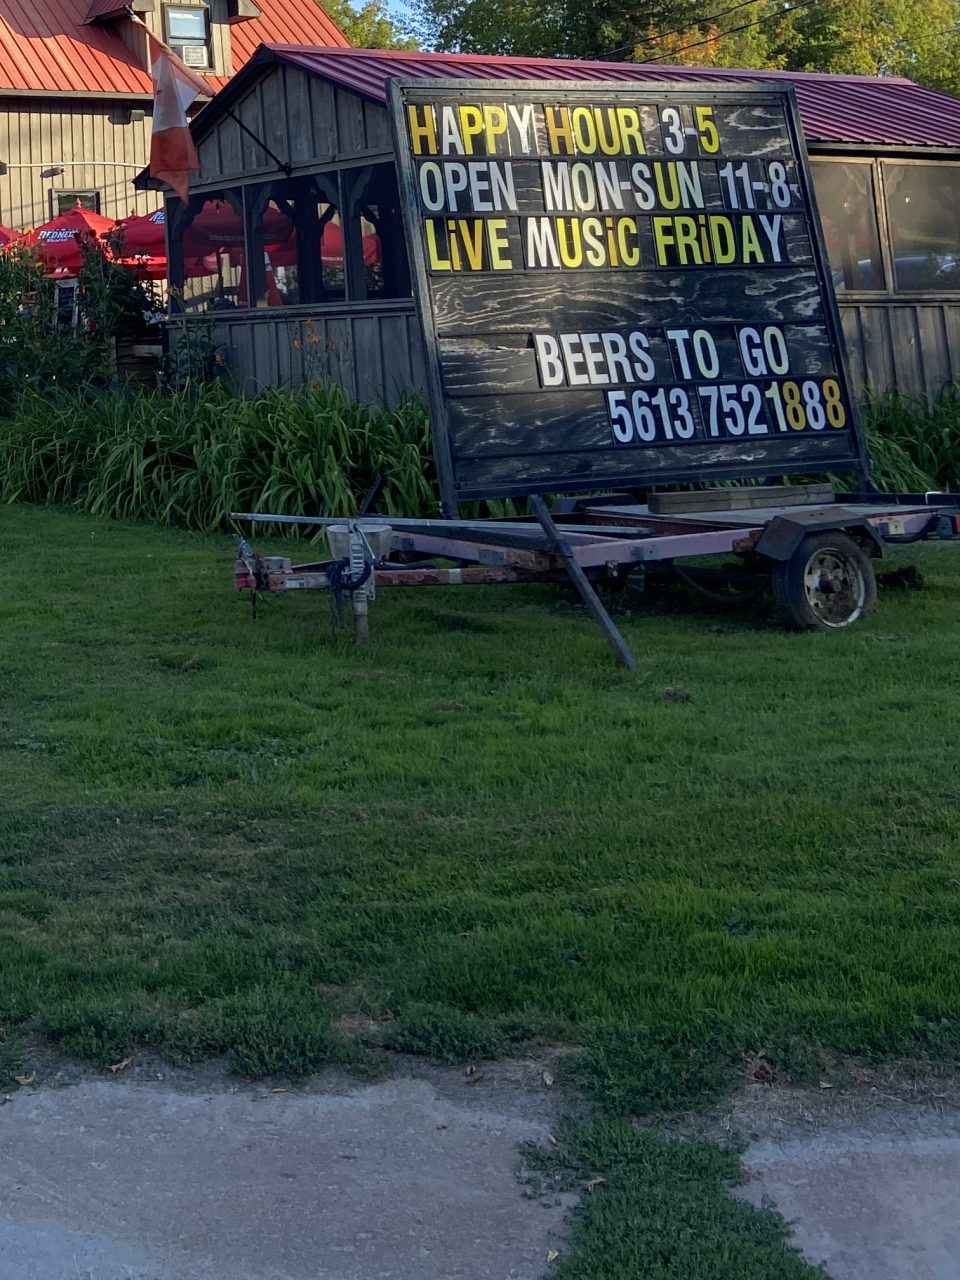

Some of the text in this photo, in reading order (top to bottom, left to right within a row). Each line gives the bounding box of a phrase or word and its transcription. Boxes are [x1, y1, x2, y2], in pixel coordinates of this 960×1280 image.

[408, 104, 720, 156] HAPPY HOUR 3-5
[419, 160, 792, 212] OPEN MON-SUN 11-8
[37, 230, 80, 240] REDNEC
[535, 325, 789, 387] BEERS TO GO
[607, 388, 695, 444] 5613
